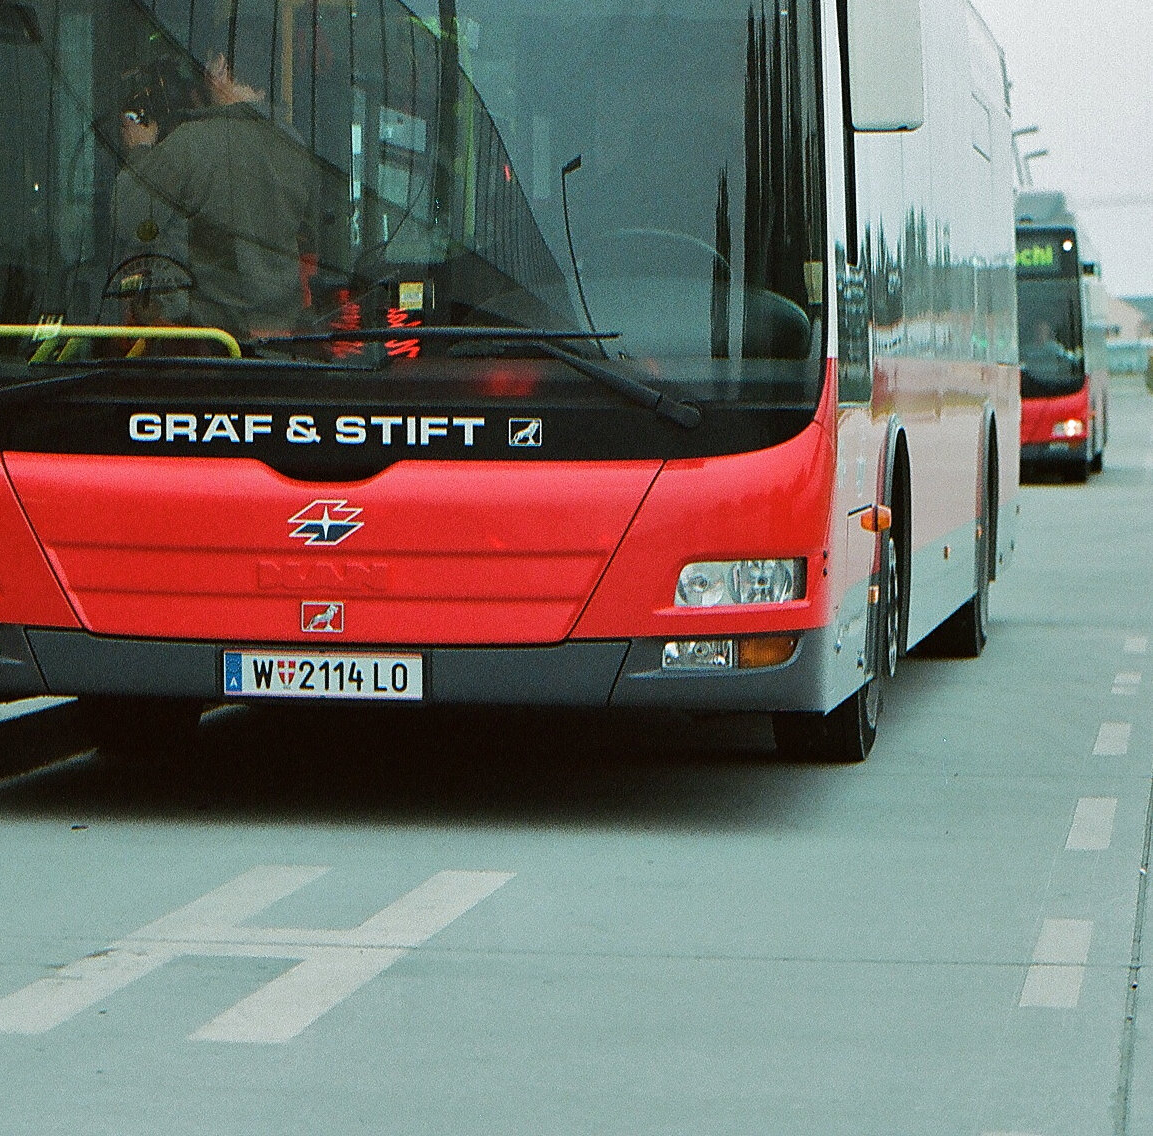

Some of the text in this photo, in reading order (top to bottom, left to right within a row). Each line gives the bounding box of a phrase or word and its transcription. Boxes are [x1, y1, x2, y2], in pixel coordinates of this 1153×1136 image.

[129, 413, 486, 446] GRÄF & STIFT
[298, 659, 364, 693] 2114
